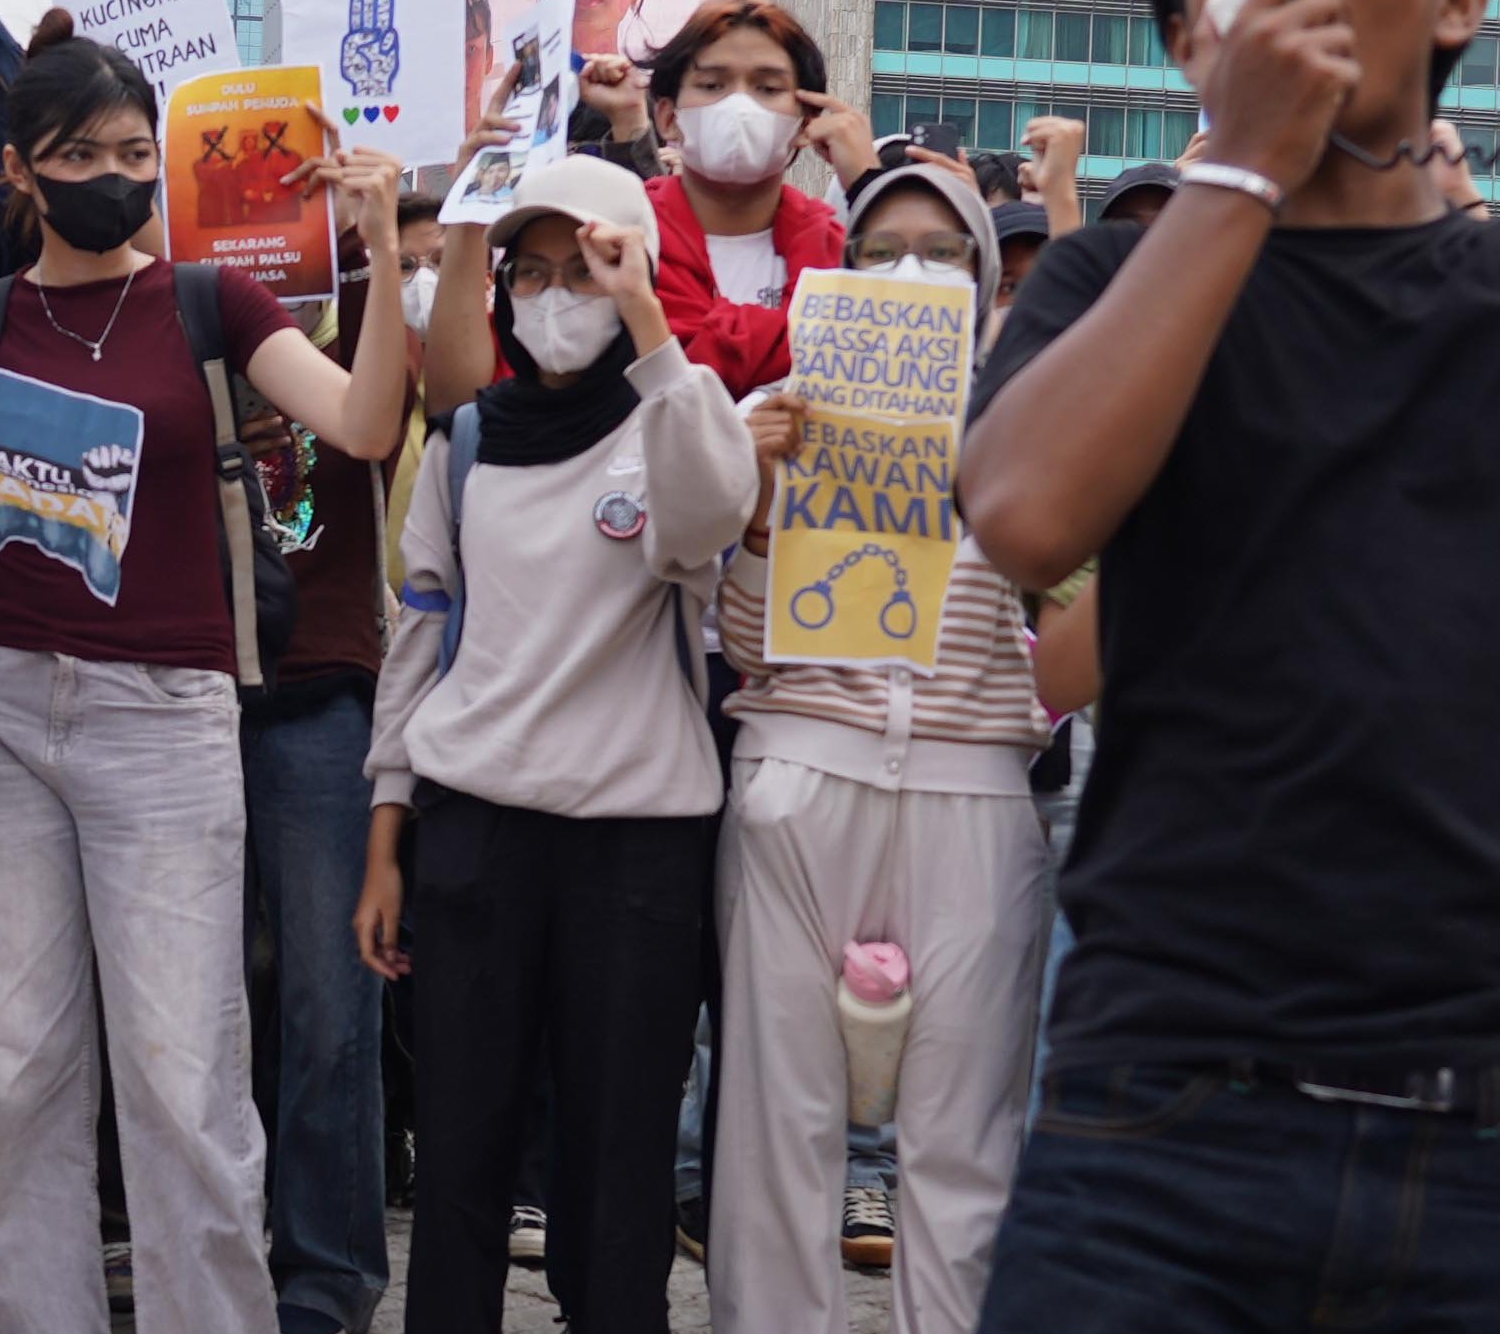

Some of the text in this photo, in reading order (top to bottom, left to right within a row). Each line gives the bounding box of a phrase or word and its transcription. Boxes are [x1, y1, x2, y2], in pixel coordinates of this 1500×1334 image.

[115, 18, 173, 53] CUMA
[213, 236, 287, 253] SEKARANG
[258, 251, 302, 266] PALSU
[801, 293, 964, 335] BEBASKAN
[794, 323, 959, 363] MASSA AKSI
[852, 387, 956, 417] DITAHAN
[783, 446, 950, 494] KAWAN
[782, 482, 953, 542] KAMI
